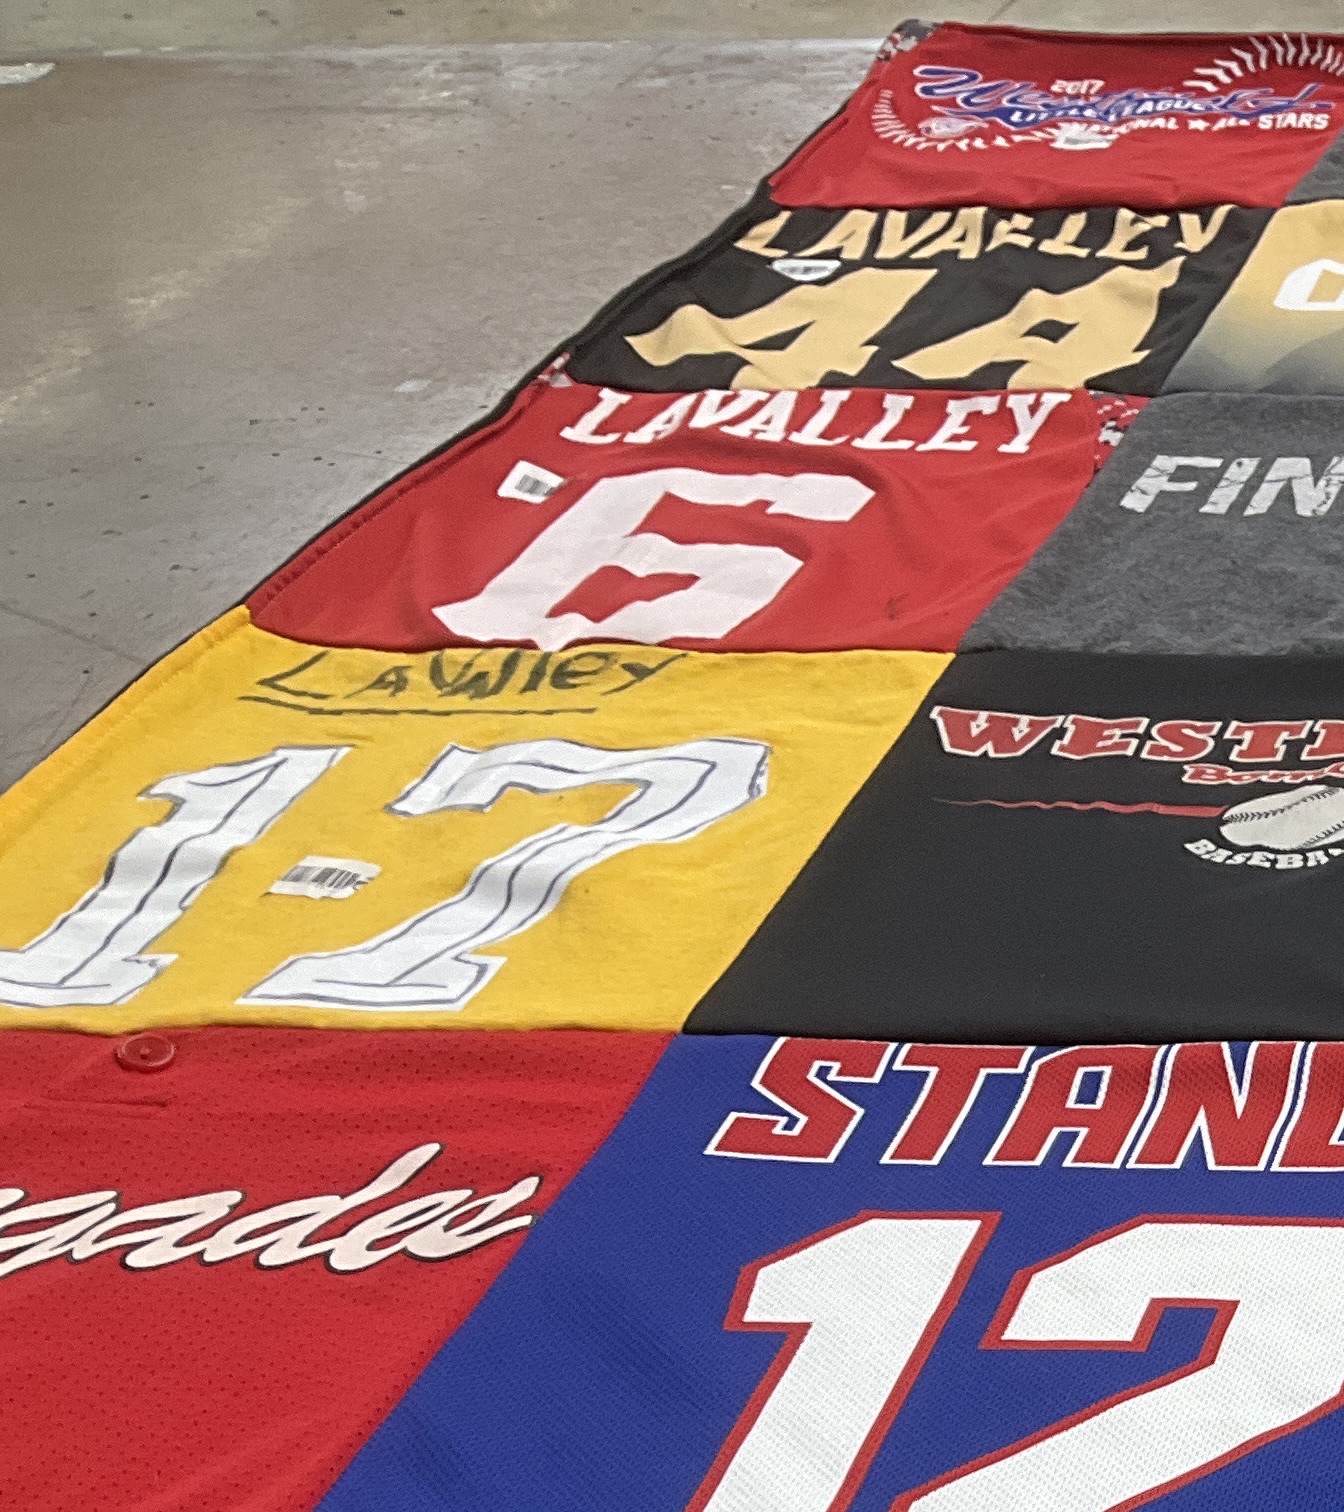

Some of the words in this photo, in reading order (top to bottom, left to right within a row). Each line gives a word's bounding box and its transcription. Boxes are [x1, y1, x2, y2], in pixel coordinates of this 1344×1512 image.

[1051, 79, 1105, 95] 2017
[1257, 113, 1331, 130] STARS
[625, 256, 1186, 390] 44
[561, 388, 1072, 453] LAVALLEY
[432, 468, 876, 650] 6
[0, 738, 770, 1012] 17
